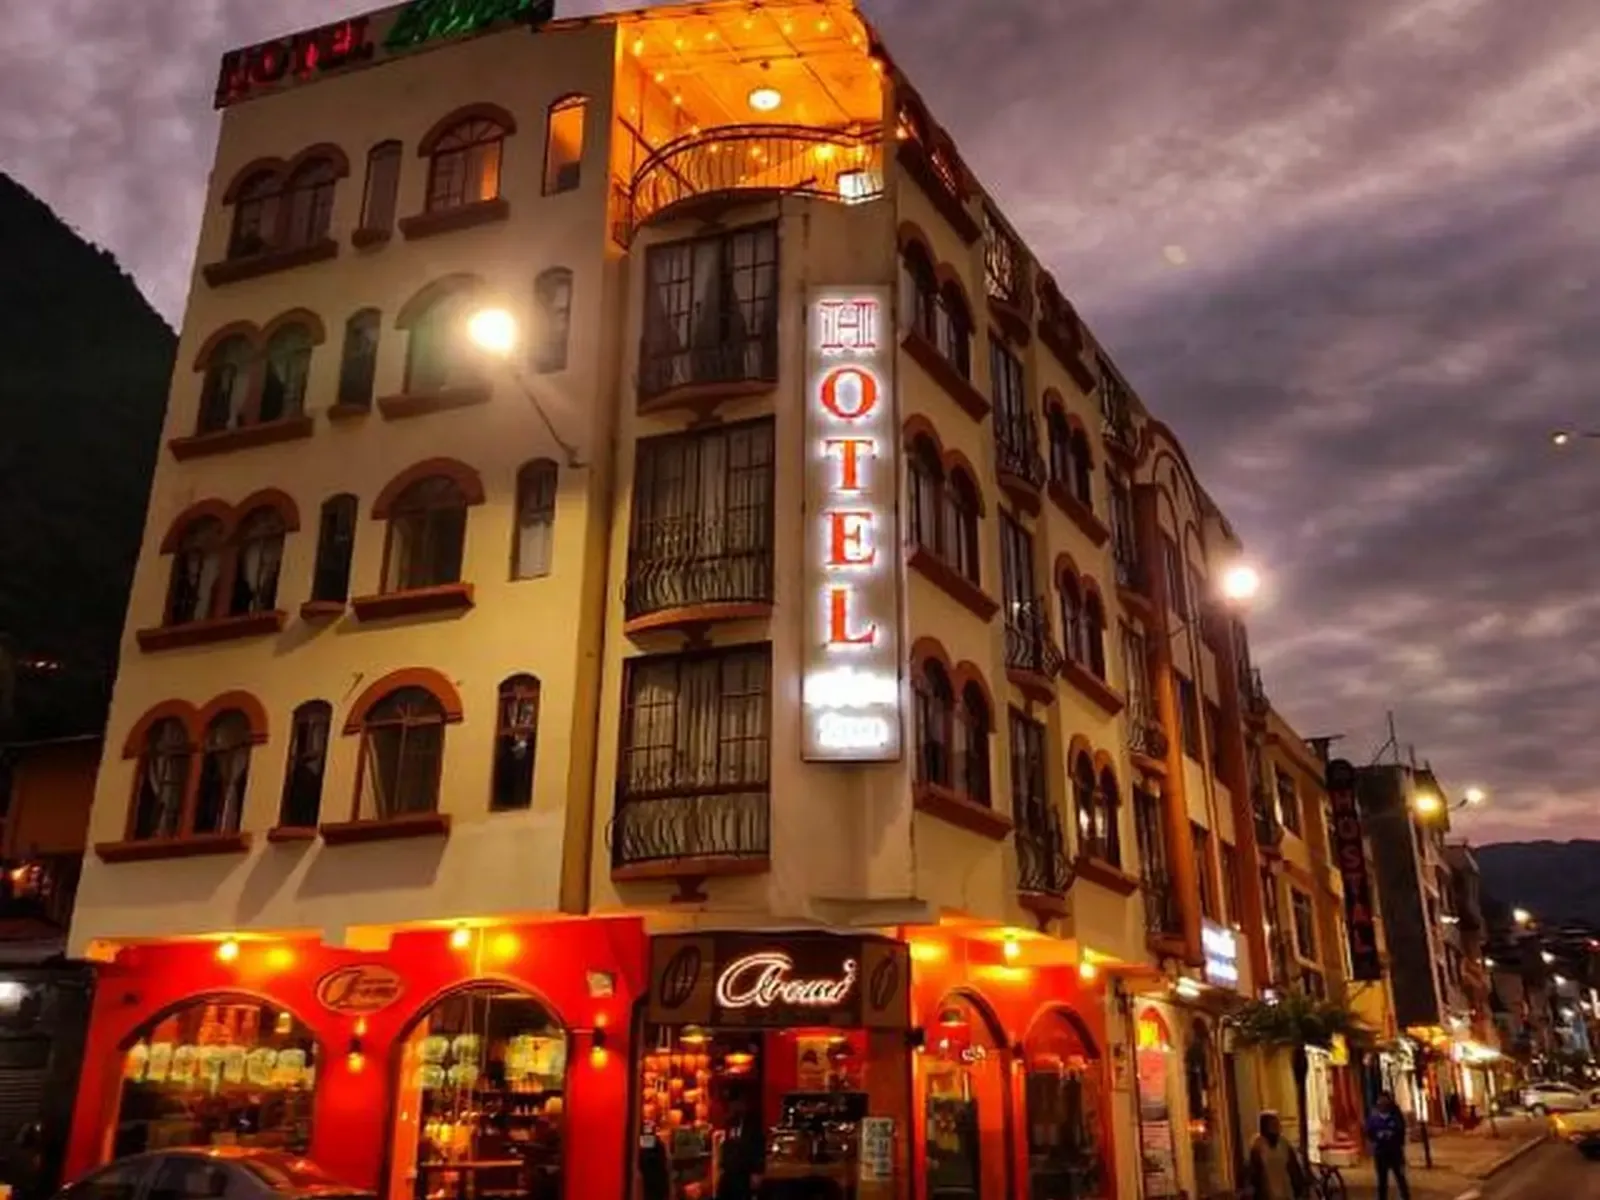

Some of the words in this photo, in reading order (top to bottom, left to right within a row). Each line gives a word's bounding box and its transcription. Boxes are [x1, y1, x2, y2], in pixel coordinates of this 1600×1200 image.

[217, 16, 375, 106] HOTEL
[820, 301, 877, 645] HOTEL
[1333, 788, 1373, 954] HOSTAL
